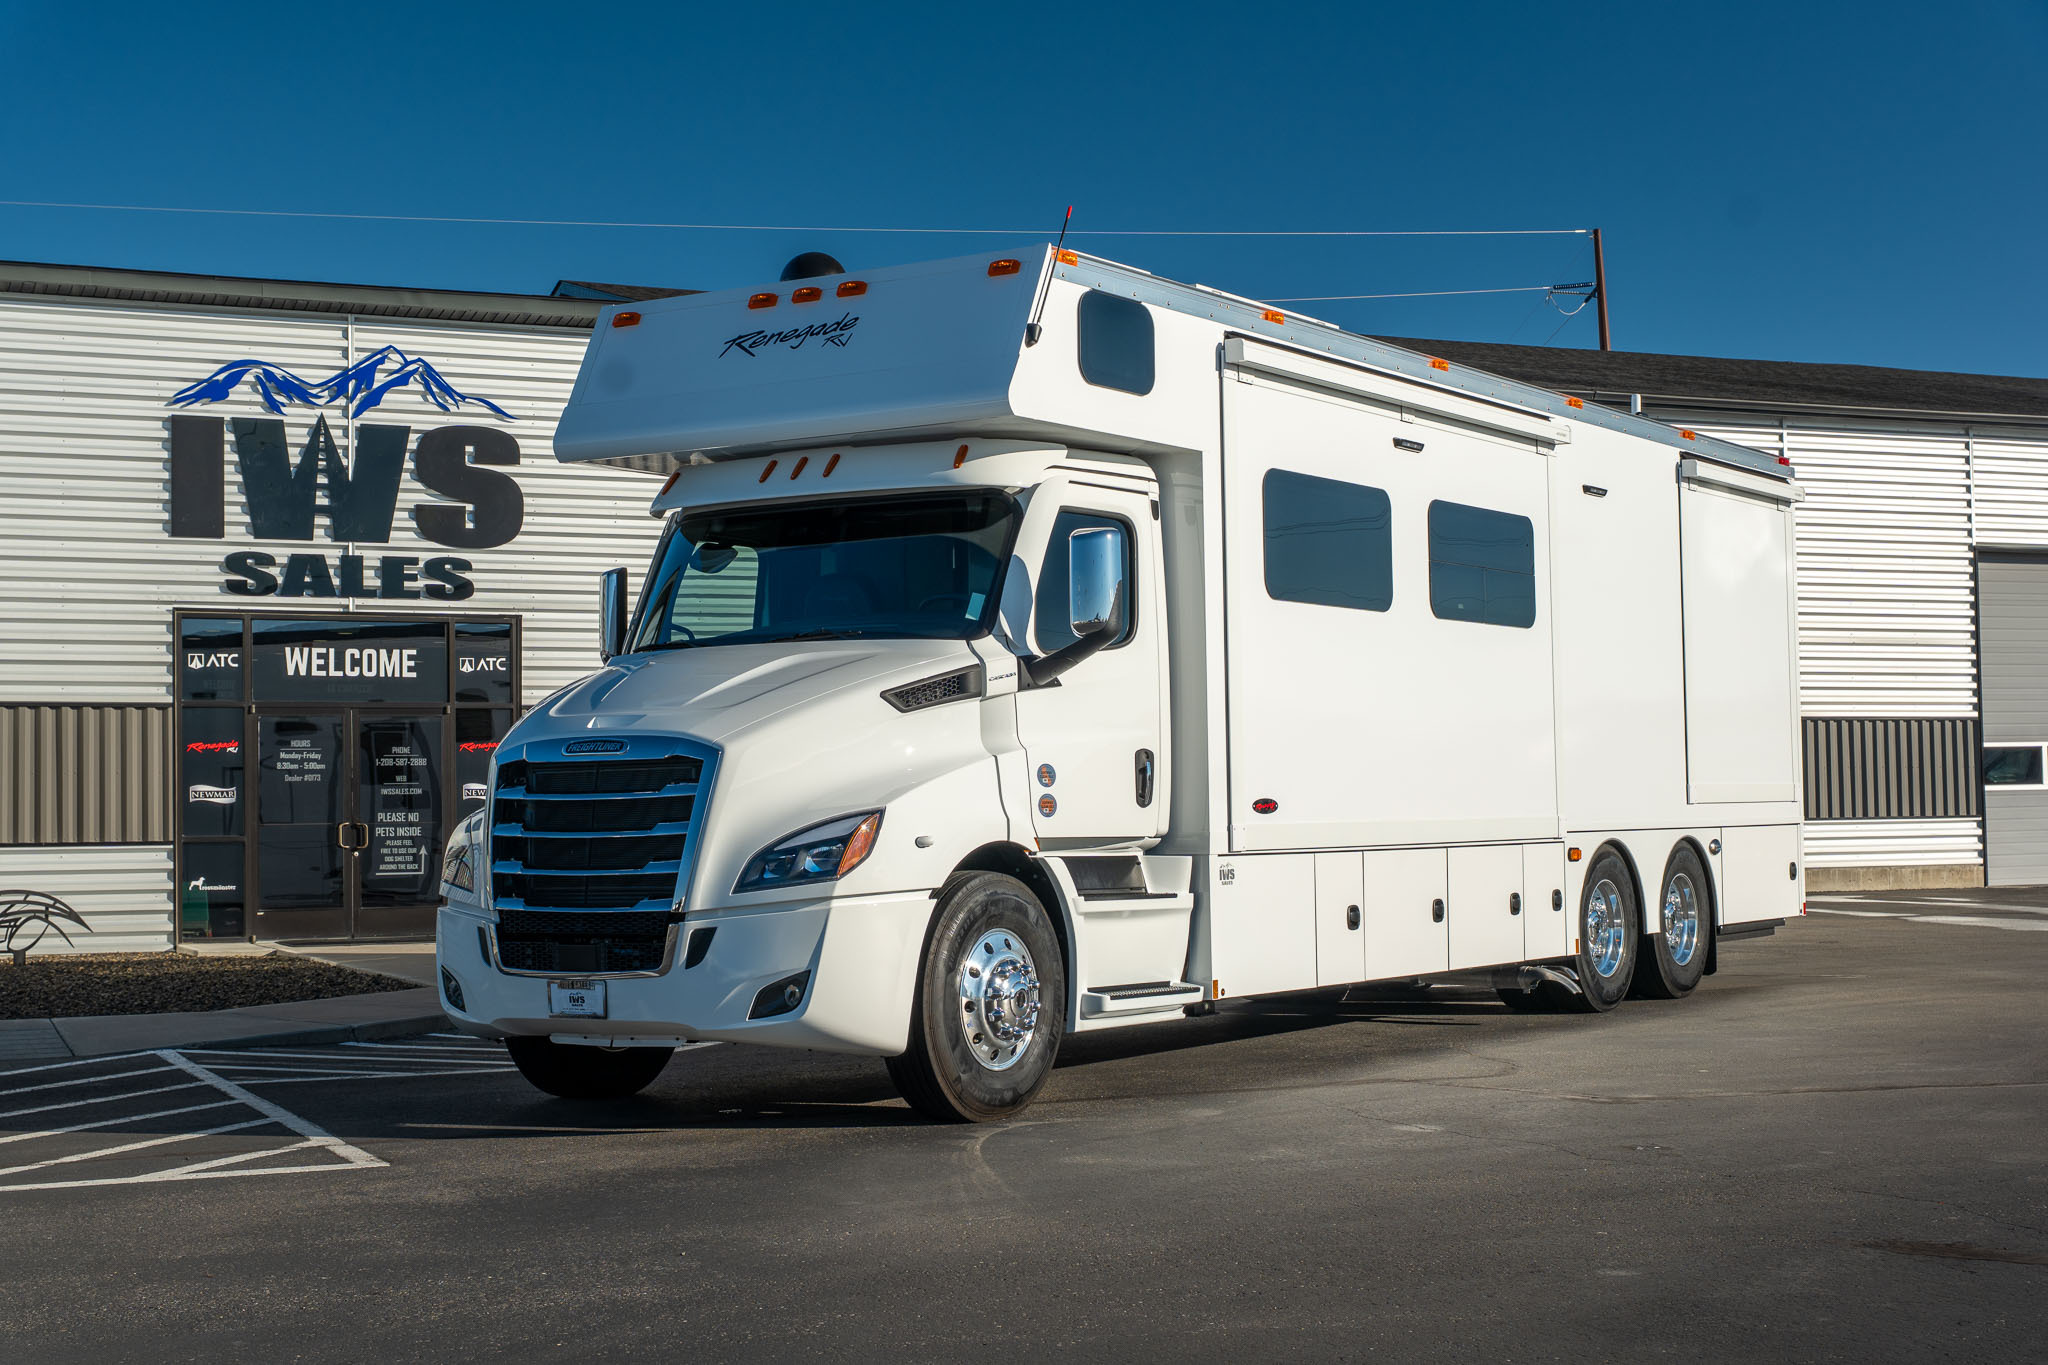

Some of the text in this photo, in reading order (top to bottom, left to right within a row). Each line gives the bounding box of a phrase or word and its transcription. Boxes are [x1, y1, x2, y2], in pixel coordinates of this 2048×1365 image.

[719, 311, 860, 359] Renegade
[821, 332, 853, 348] RV
[170, 411, 524, 549] IWS
[224, 551, 475, 601] SALES
[206, 653, 239, 668] ATC
[284, 646, 417, 678] WELCOME
[476, 657, 507, 671] ATC
[186, 739, 239, 753] Renegade
[290, 739, 311, 748] HOURS
[458, 742, 501, 753] Renega
[567, 742, 620, 752] FREIGHTLINER
[391, 746, 412, 754] PHONE
[279, 751, 322, 761] Monday-Friday
[284, 774, 303, 782] Dealer
[380, 788, 422, 796] IWSSALES.COM
[377, 812, 420, 822] PLEASE NO
[375, 826, 422, 837] PETS INSIDE
[1219, 868, 1235, 881] IWS
[568, 995, 586, 1004] IWS
